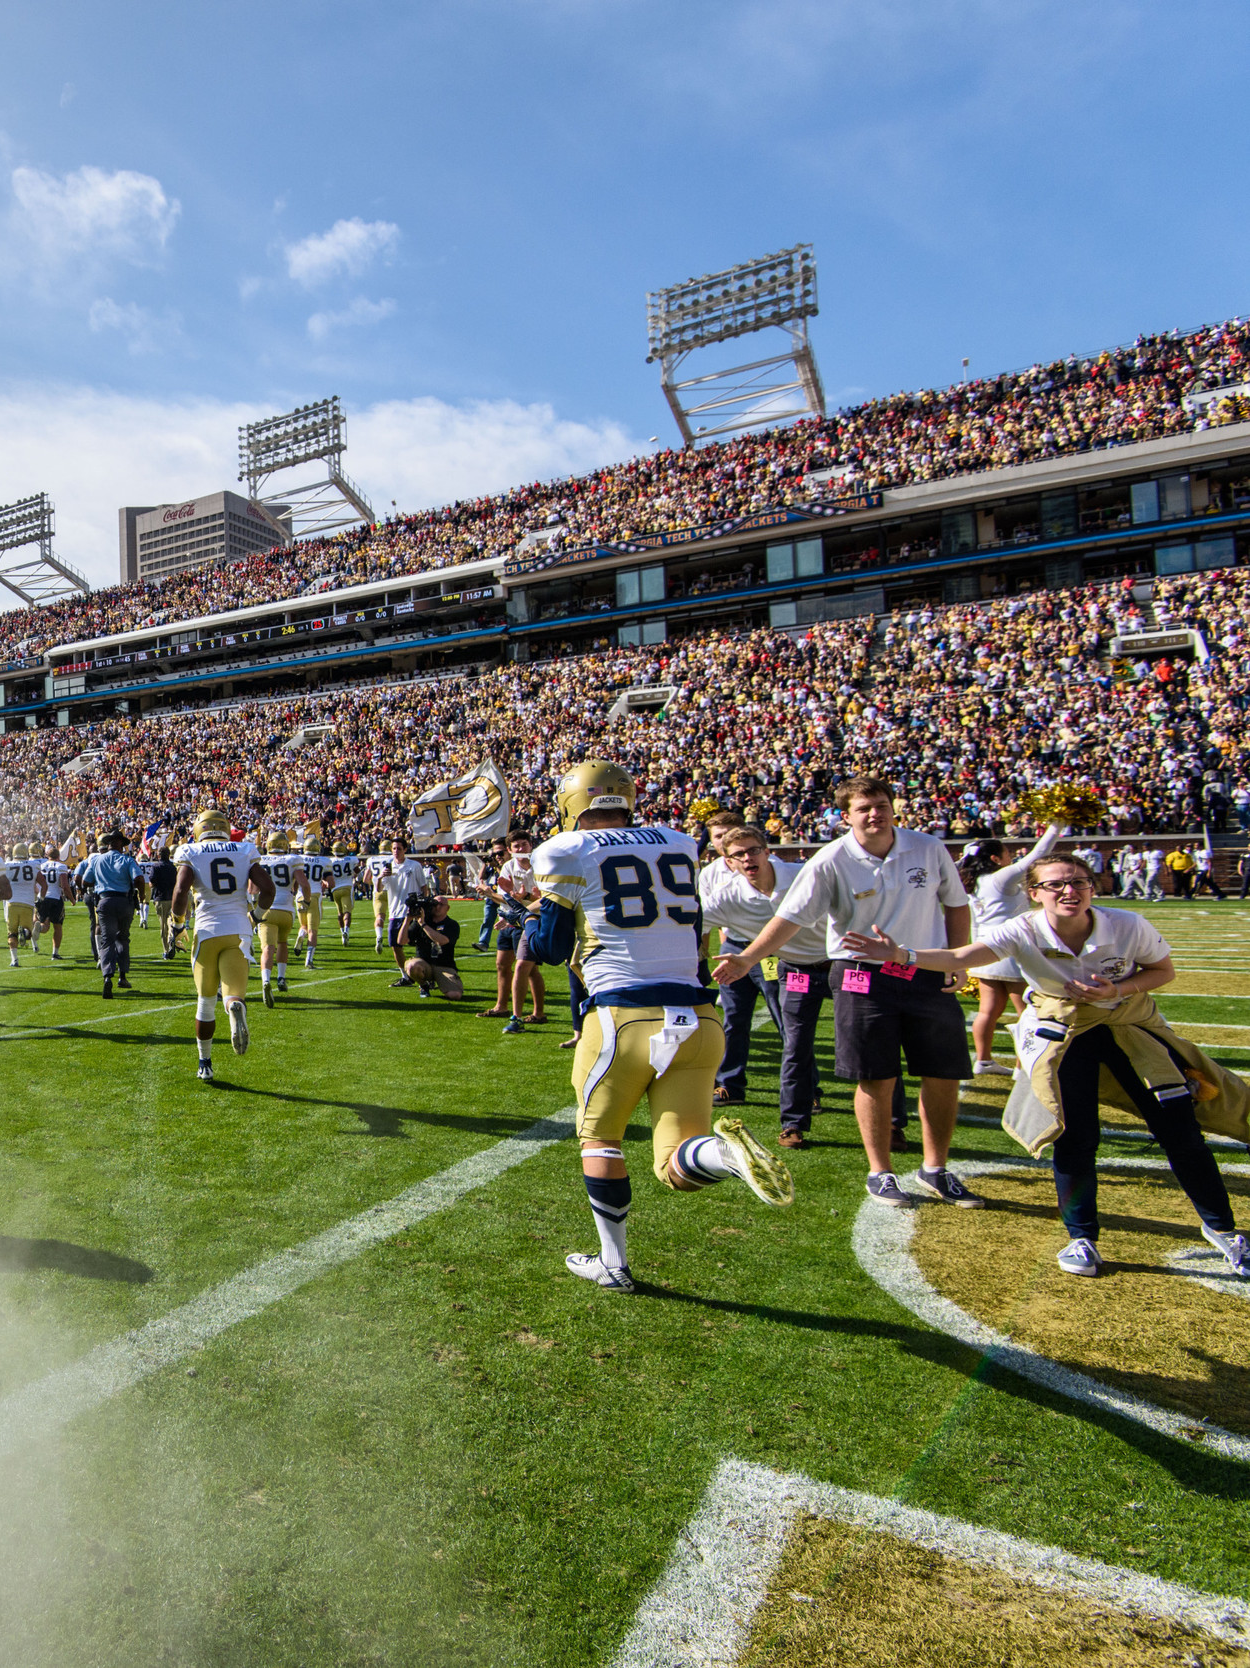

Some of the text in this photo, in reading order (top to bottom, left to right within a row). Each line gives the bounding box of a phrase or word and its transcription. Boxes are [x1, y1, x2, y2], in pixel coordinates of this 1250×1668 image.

[666, 533, 692, 544] TECH
[466, 589, 493, 600] 11:57 AM
[281, 625, 296, 635] 2:46
[313, 620, 322, 629] 25
[599, 796, 623, 804] JACKETS
[587, 828, 669, 847] BARTON
[201, 842, 239, 853] MILTON
[10, 865, 34, 882] 78
[210, 857, 238, 896] 6
[332, 863, 352, 879] 94
[598, 852, 699, 930] 89
[766, 961, 775, 971] 2
[791, 975, 805, 984] PG
[849, 972, 865, 983] PG
[675, 1015, 688, 1024] R
